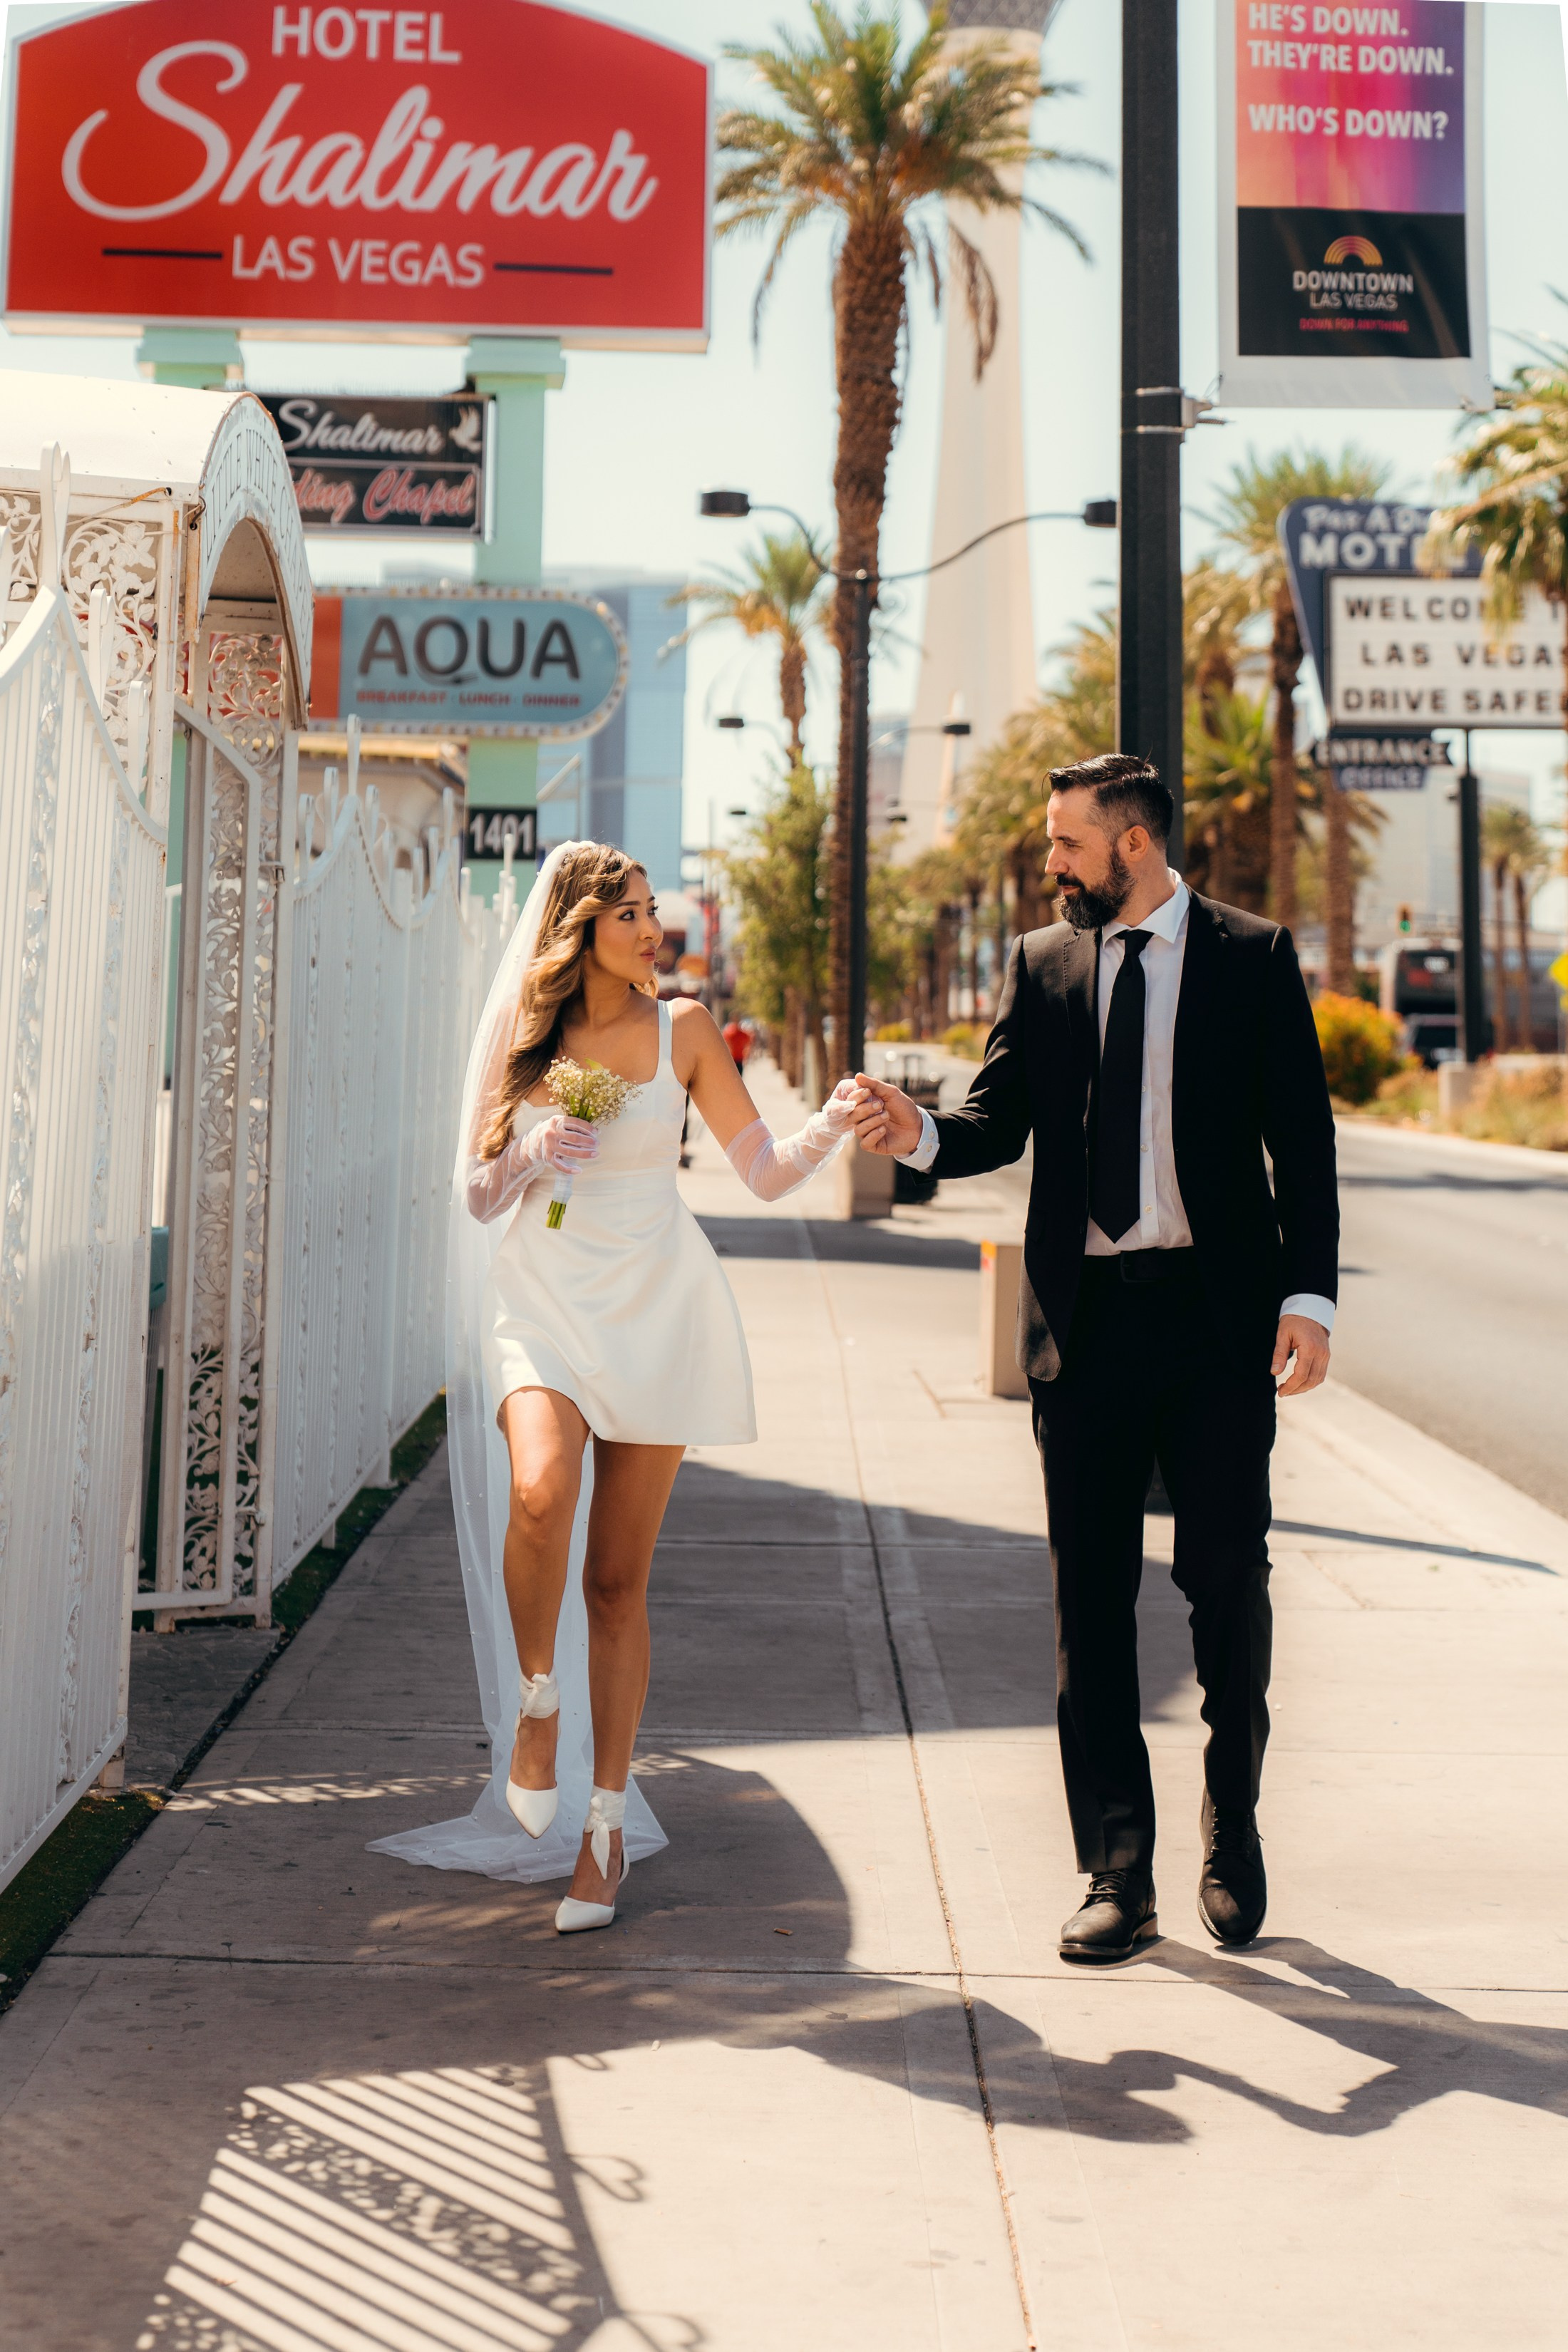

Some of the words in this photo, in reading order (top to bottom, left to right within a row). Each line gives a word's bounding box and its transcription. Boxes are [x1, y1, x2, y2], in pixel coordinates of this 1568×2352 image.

[272, 5, 461, 63] HOTEL
[1249, 4, 1306, 31] HE'S
[1313, 7, 1409, 36] DOWN.
[1247, 40, 1352, 72] THEY'RE
[1358, 46, 1454, 76] DOWN.
[61, 40, 659, 222] Shalimar
[1249, 104, 1339, 135] WHO'S
[1345, 109, 1449, 140] DOWN?
[232, 234, 315, 281] LAS
[329, 238, 485, 287] VEGAS
[1293, 270, 1414, 294] DOWNTOWN
[1309, 292, 1343, 309] LAS
[1344, 293, 1398, 311] VEGAS
[1299, 318, 1333, 331] DOWN
[1335, 318, 1354, 331] FOR
[1356, 319, 1409, 333] ANYTHING
[279, 398, 445, 455] Shalimar
[362, 465, 477, 526] Chapel
[205, 432, 242, 568] LITTLE
[245, 429, 278, 514] WHITE
[280, 485, 311, 666] CHAPEL
[1345, 596, 1524, 621] WELCO
[359, 614, 580, 683] AQUA
[1361, 642, 1430, 667] LAS
[1456, 643, 1566, 667] VEGA
[357, 689, 447, 704] BREAKFAST
[459, 691, 510, 706] LUNCH
[523, 693, 580, 707] DINNER
[1343, 688, 1445, 712] DRIVE
[1463, 689, 1566, 712] SAFE
[1316, 738, 1448, 765] ENTRANCE
[470, 813, 535, 855] 1401
